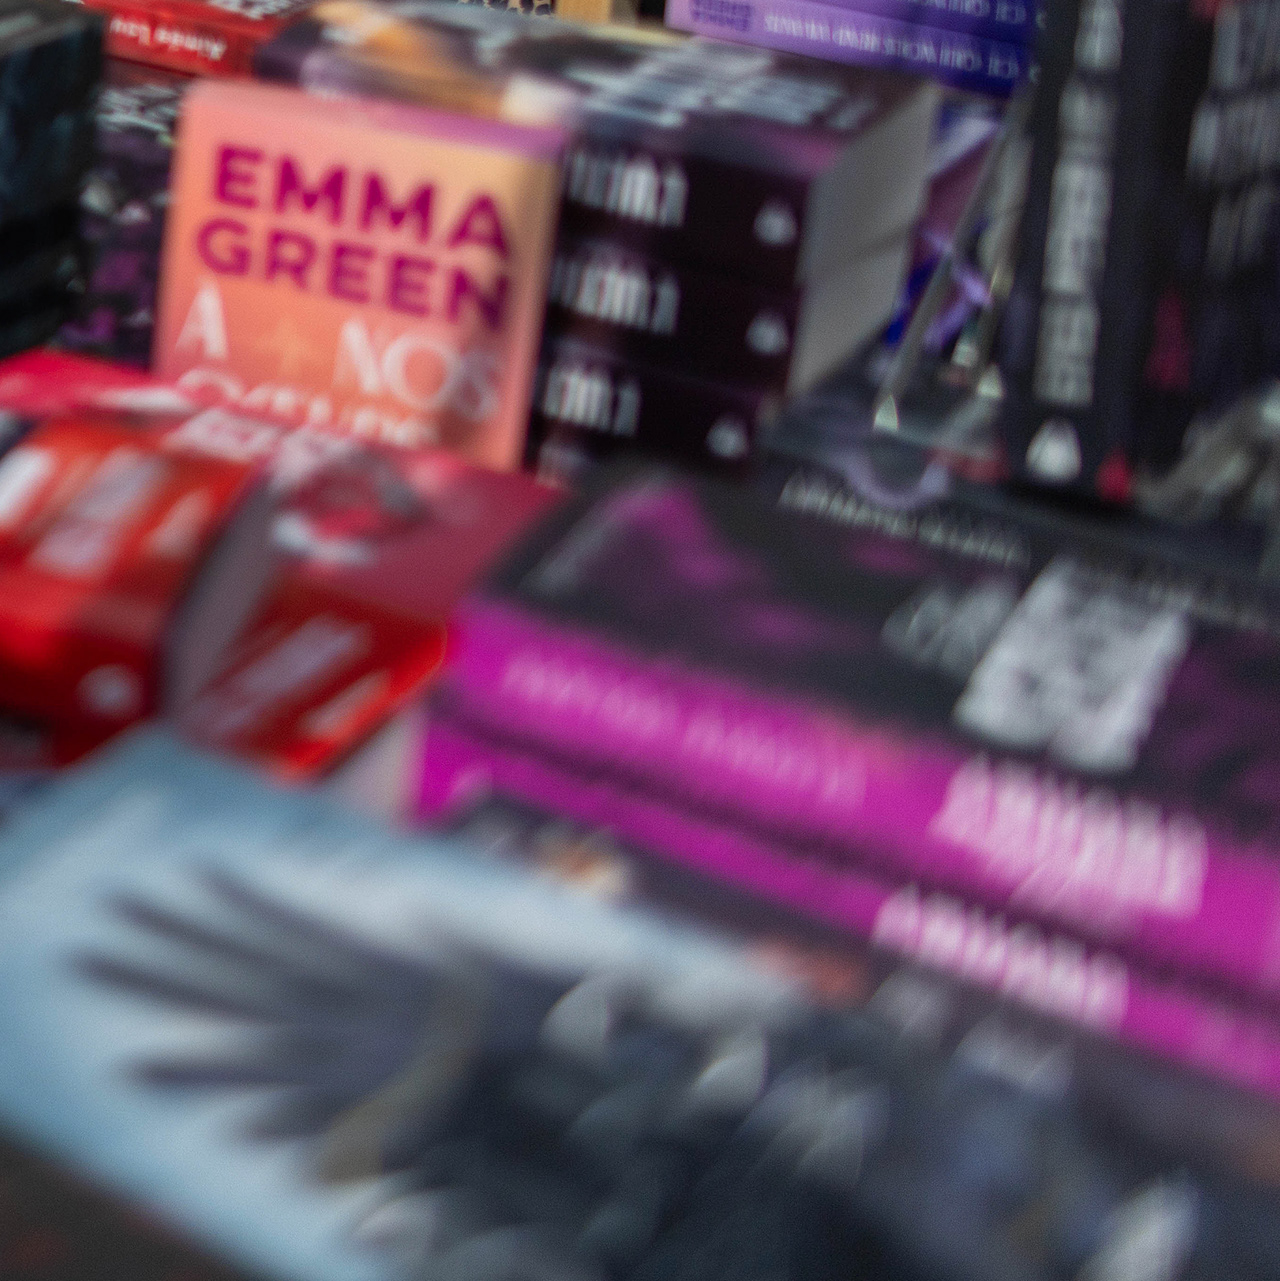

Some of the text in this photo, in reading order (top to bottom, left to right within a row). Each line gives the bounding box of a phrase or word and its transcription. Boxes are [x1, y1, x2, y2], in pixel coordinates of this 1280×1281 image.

[109, 18, 228, 61] Aimée Lou
[213, 144, 514, 256] EMMA
[195, 218, 514, 329] GREEN
